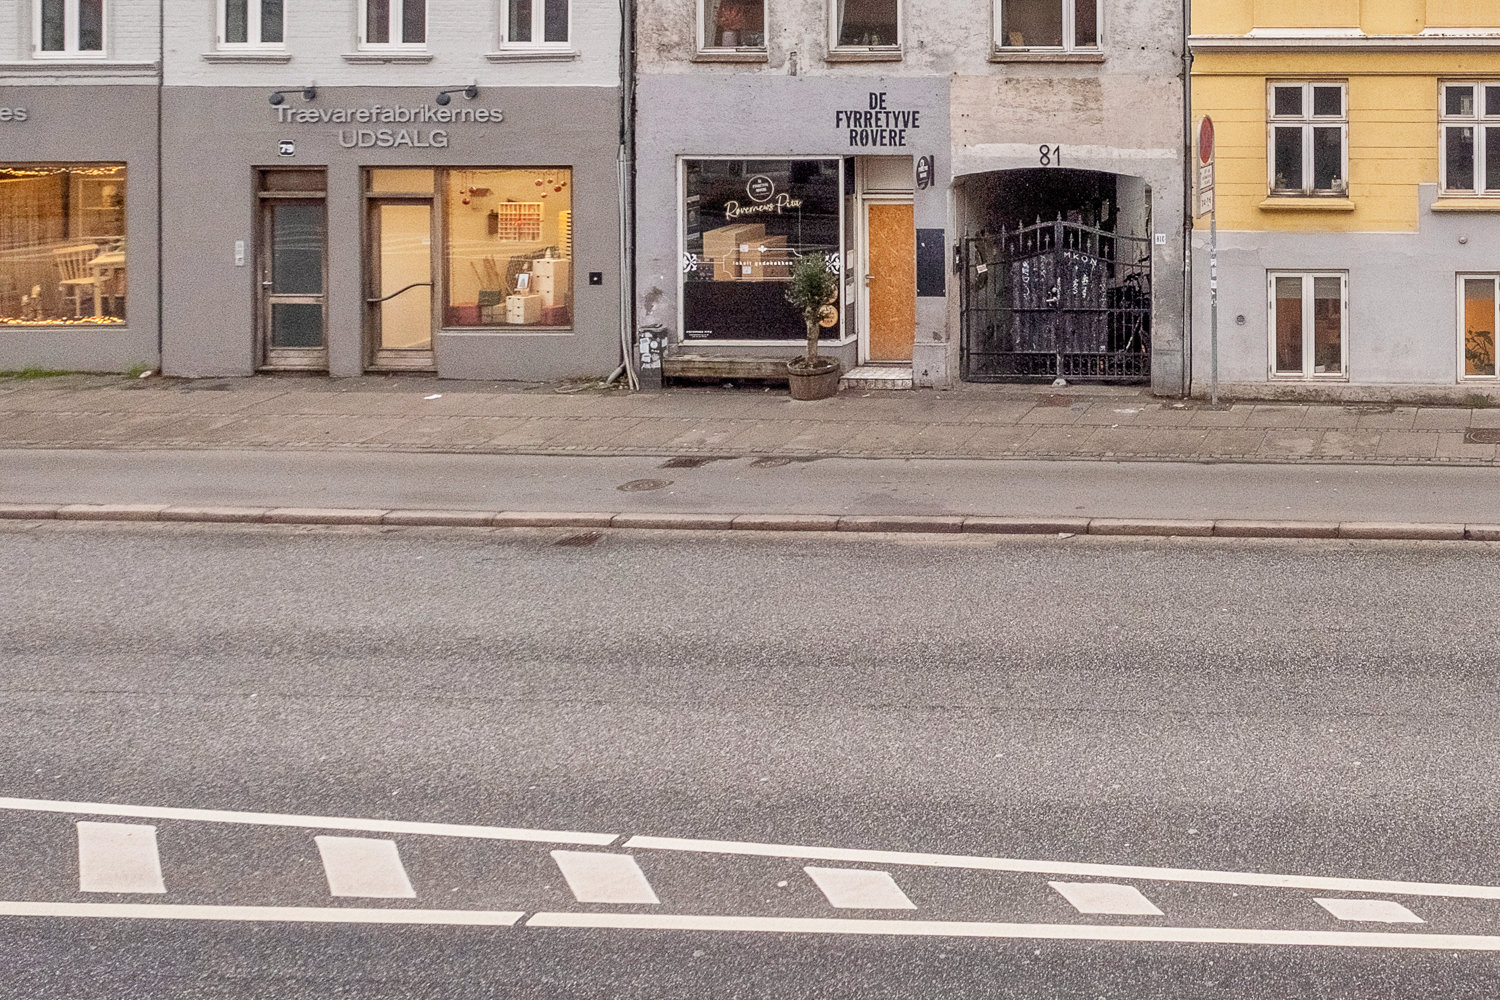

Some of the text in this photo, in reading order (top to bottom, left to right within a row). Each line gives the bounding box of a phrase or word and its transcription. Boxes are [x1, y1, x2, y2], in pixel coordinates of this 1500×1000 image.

[868, 91, 888, 111] DE
[0, 106, 28, 121] es
[271, 103, 505, 124] Trævarefabrikernes
[835, 110, 920, 129] FYRRETYVE
[338, 128, 449, 148] UDSALG
[849, 128, 907, 147] RØVERE
[280, 144, 295, 153] 79
[1039, 144, 1061, 167] 81
